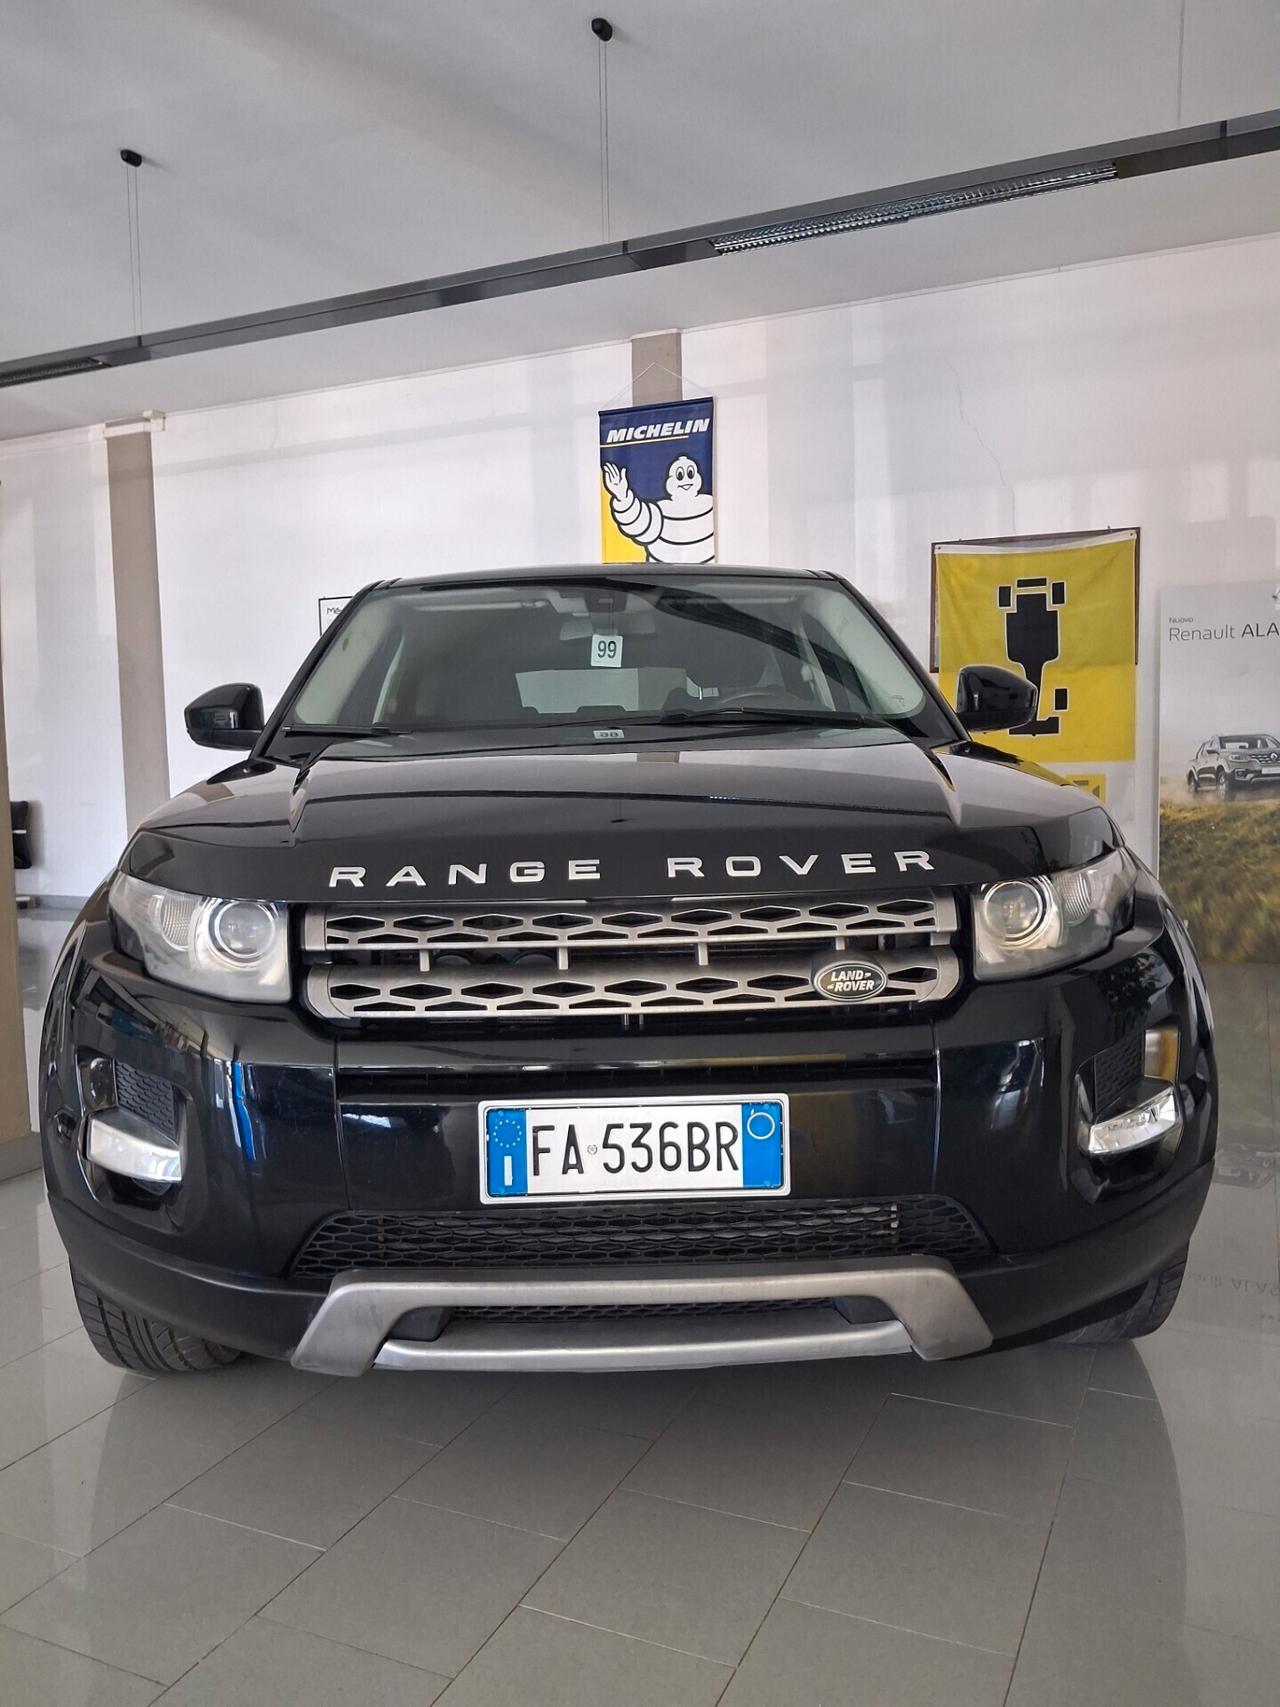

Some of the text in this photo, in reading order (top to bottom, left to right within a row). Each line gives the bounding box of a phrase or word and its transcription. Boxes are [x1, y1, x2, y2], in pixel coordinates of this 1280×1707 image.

[606, 418, 710, 443] MICHELIN
[1168, 616, 1194, 624] Nuovo
[1168, 622, 1280, 642] Renault ALA
[597, 640, 617, 659] 99
[329, 850, 935, 888] RANGE ROVER
[831, 969, 864, 982] LAND
[834, 979, 875, 992] ROVER
